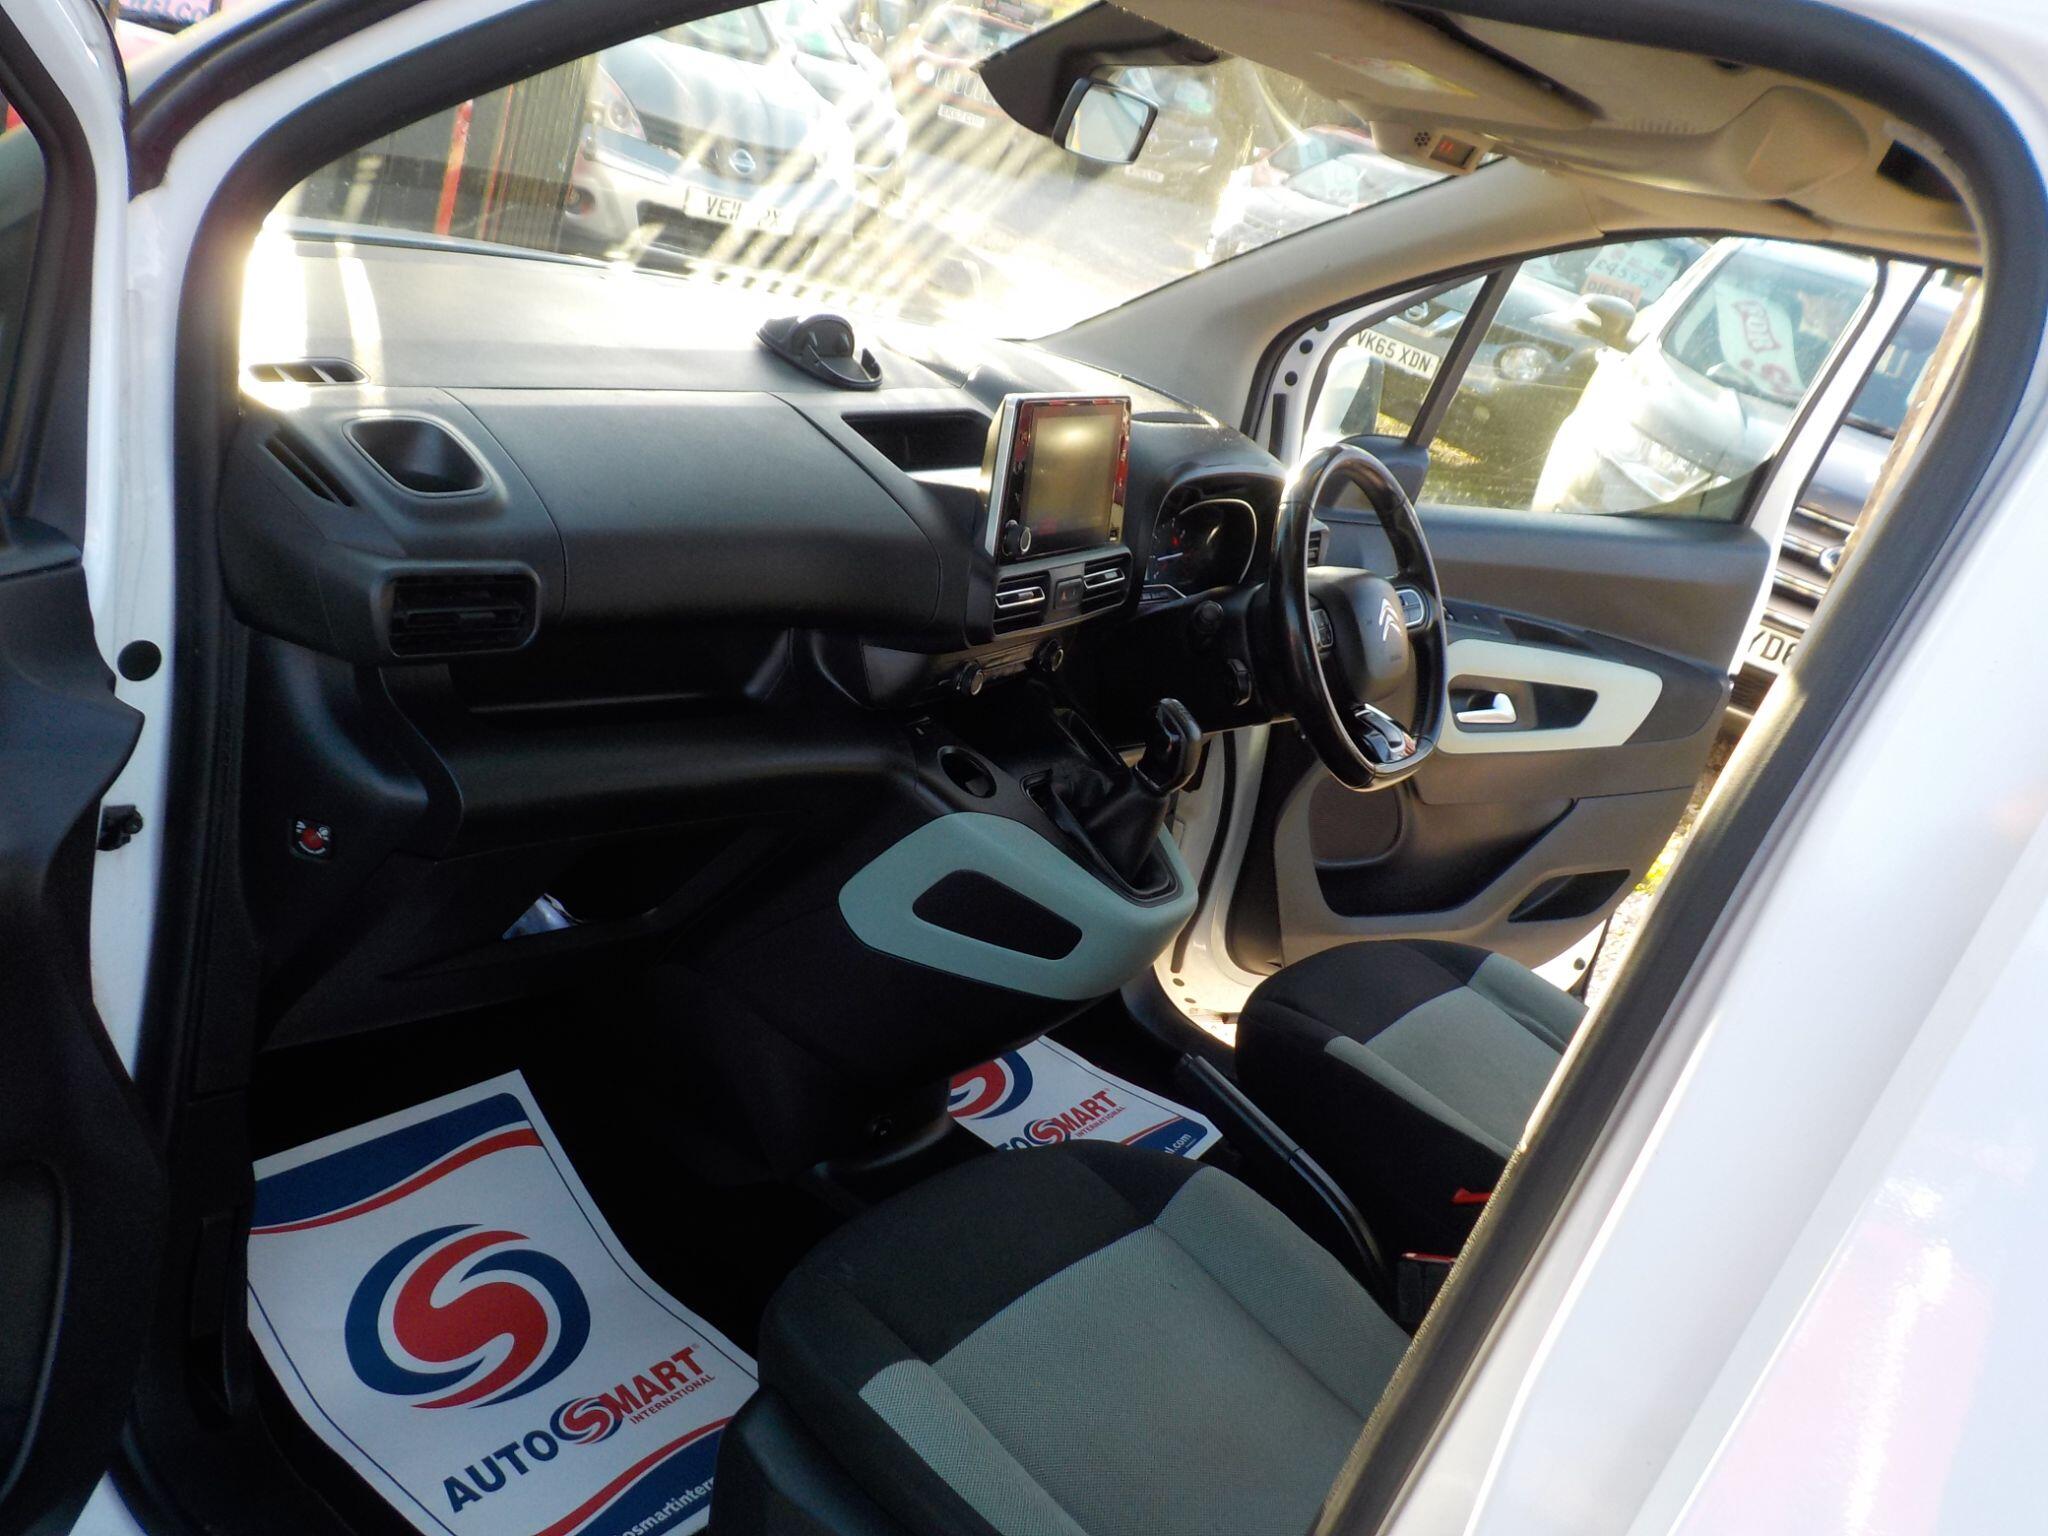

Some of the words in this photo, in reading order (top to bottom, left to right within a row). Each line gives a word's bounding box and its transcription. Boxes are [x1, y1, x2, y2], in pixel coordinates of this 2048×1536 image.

[1357, 331, 1396, 358] VK65
[1398, 346, 1431, 372] XDN
[1075, 1106, 1126, 1137] INTERNATIONAL
[629, 1373, 716, 1425] INTERNATIONAL
[442, 1346, 704, 1513] AUTOSMART
[613, 1476, 714, 1536] osmartinter
